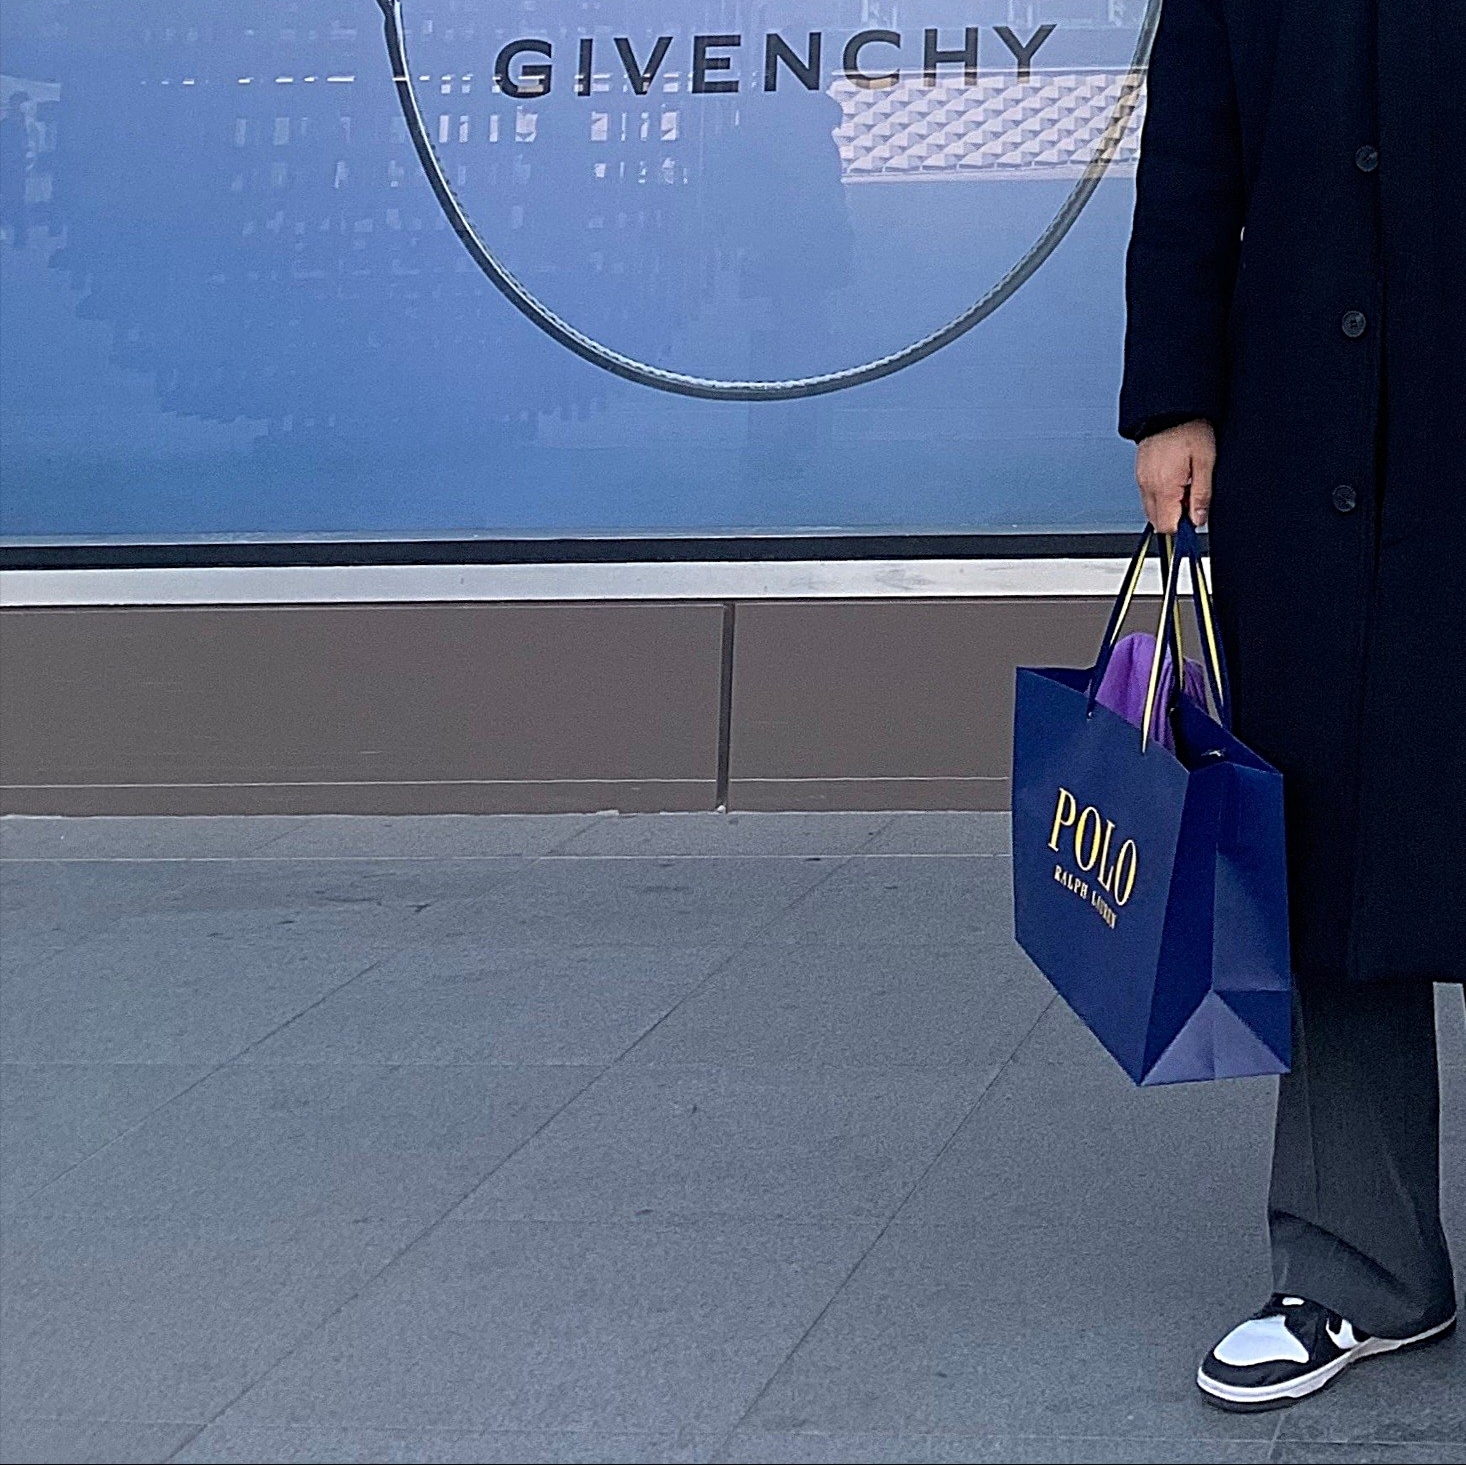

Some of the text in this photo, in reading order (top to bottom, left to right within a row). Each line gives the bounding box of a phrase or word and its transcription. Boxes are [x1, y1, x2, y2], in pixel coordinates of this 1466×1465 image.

[493, 24, 1057, 99] GIVENCHY
[1048, 787, 1137, 906] POLO
[1054, 864, 1088, 899] RALPH
